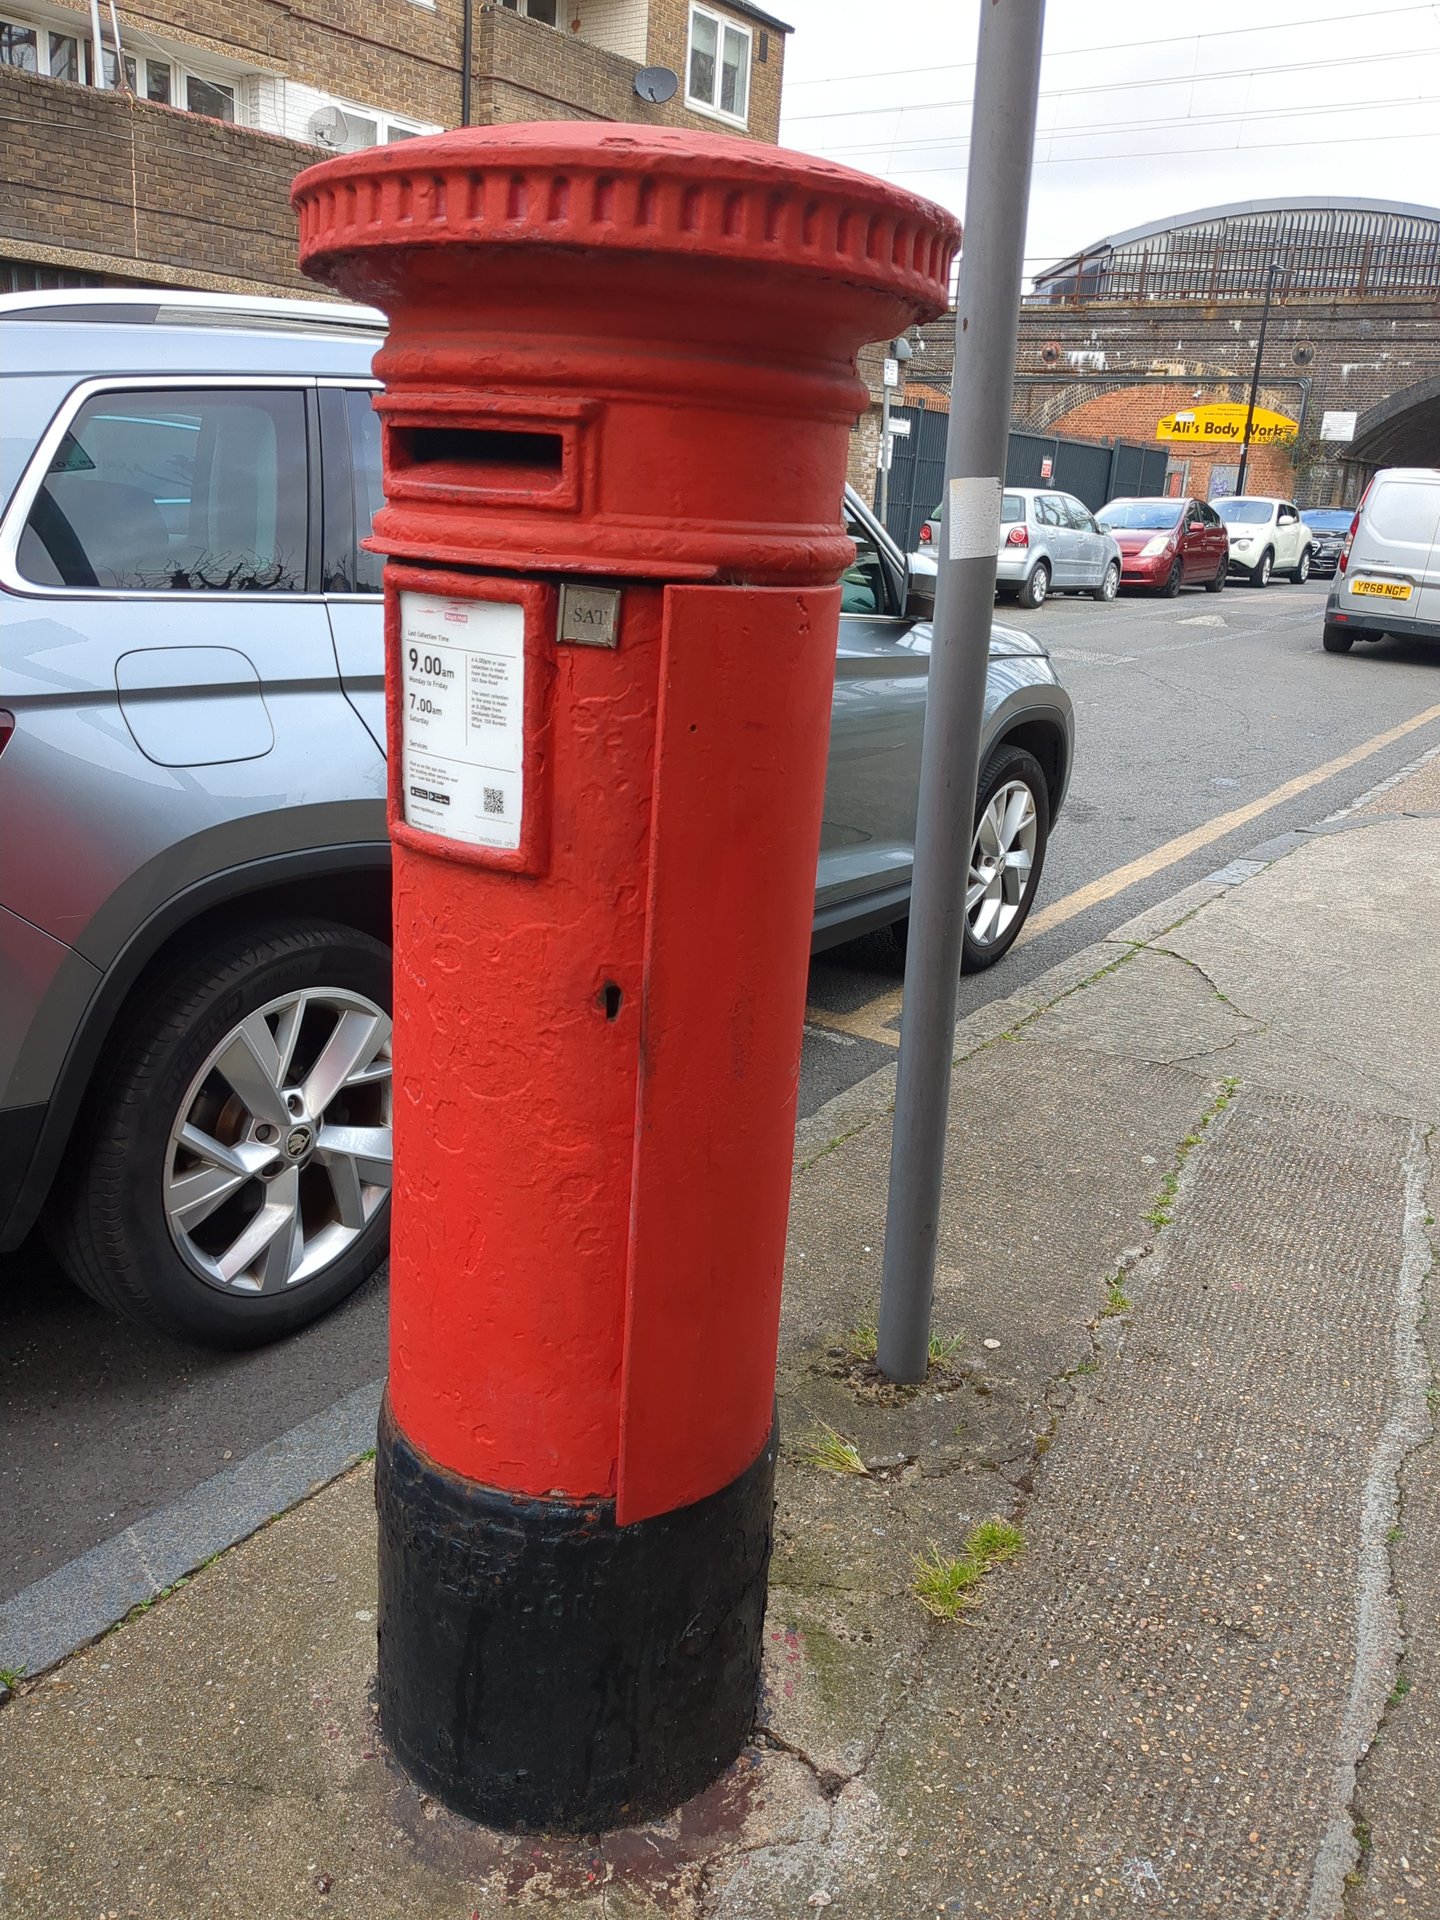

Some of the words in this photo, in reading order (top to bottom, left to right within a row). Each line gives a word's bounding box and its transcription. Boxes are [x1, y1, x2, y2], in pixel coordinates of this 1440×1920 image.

[1172, 421, 1200, 434] Ali's
[1204, 422, 1239, 438] Body
[1358, 582, 1382, 593] YR68
[1385, 586, 1406, 596] NGF
[573, 608, 608, 624] SAT
[417, 630, 437, 640] Collection
[409, 648, 454, 678] 9.00am
[409, 676, 426, 686] Monday
[433, 681, 448, 690] Friday
[410, 693, 442, 716] 7.00am
[409, 714, 429, 726] Saturday
[409, 739, 428, 750] Services
